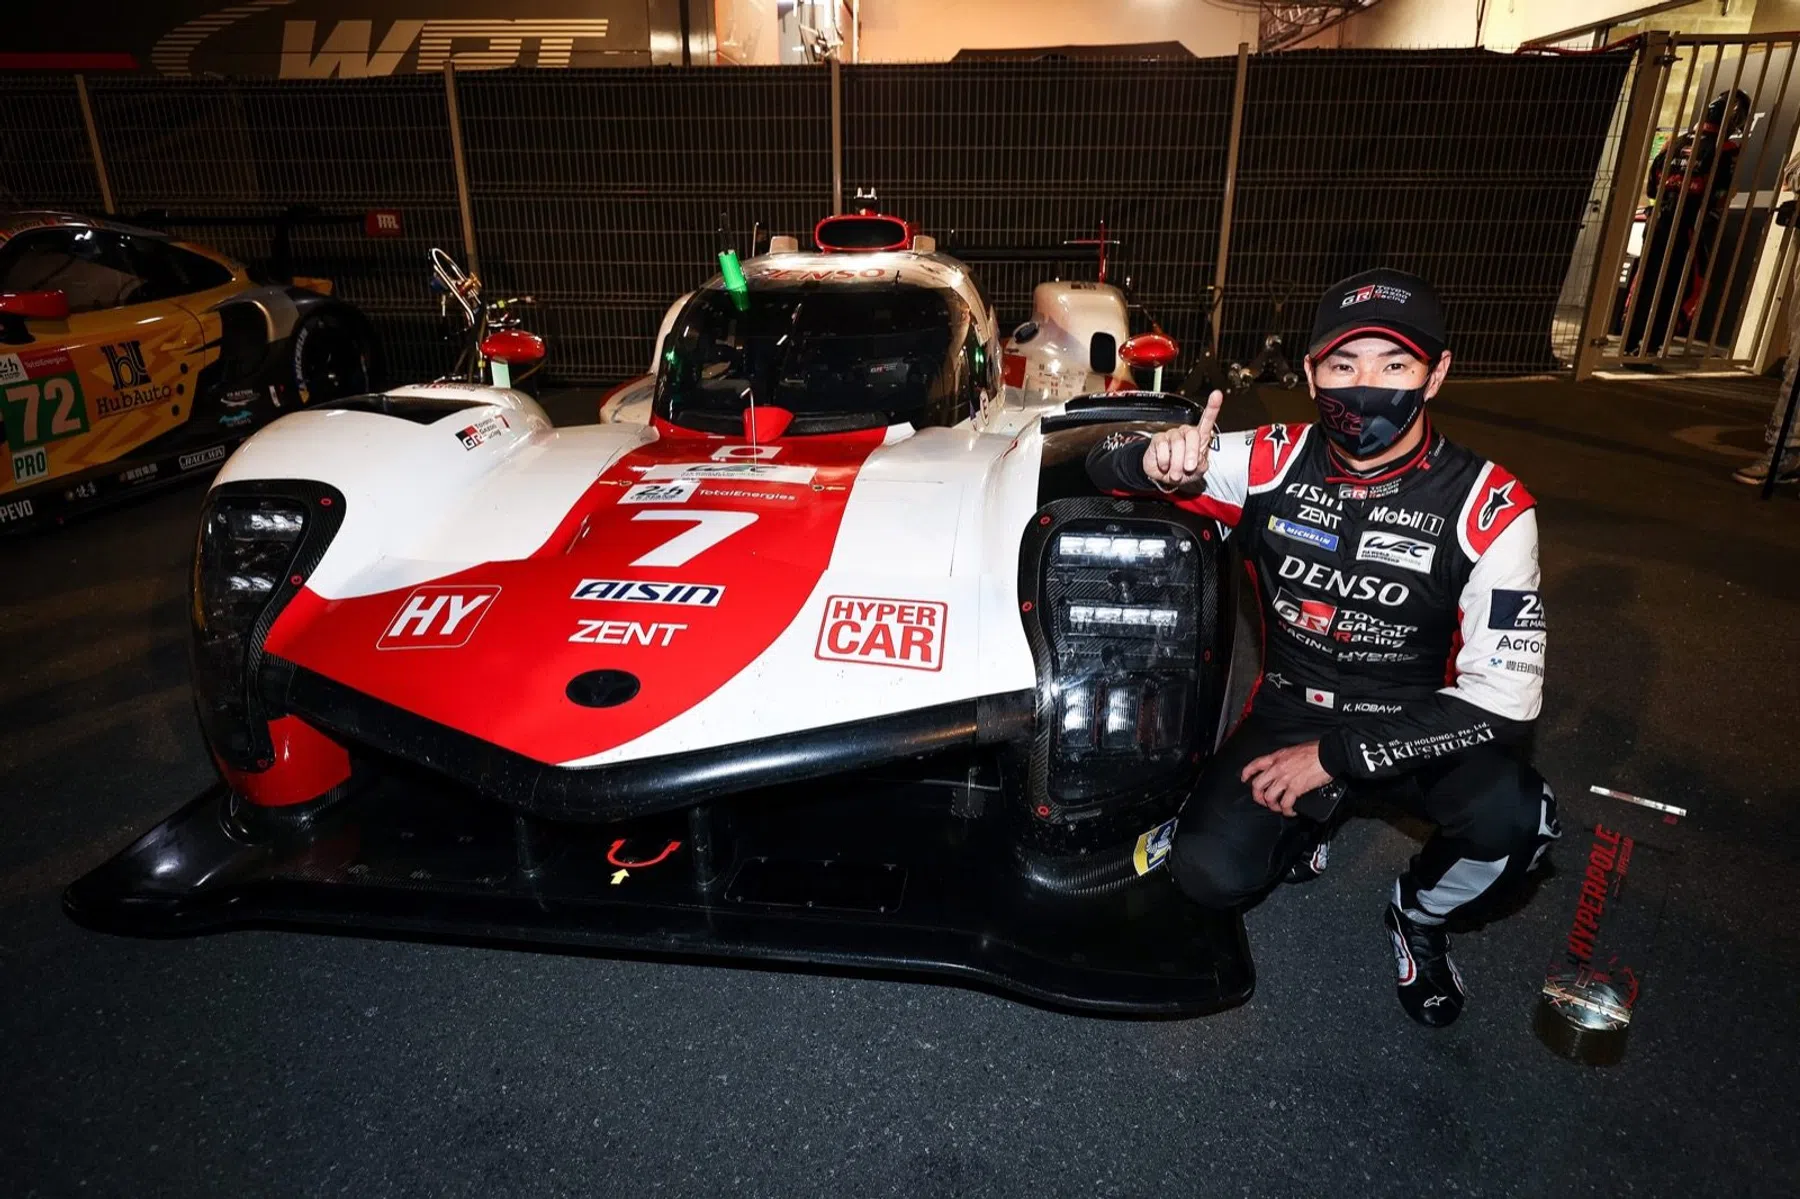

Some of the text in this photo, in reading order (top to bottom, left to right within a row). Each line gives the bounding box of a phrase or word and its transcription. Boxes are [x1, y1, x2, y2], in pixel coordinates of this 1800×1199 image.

[1342, 291, 1370, 306] GR
[6, 377, 81, 442] 72
[95, 383, 172, 416] HubAuto
[14, 451, 46, 479] PRO
[699, 489, 796, 500] TotalEnergies
[1340, 488, 1367, 499] GR
[1297, 504, 1342, 530] ZENT
[1368, 506, 1424, 529] Mobil
[628, 510, 760, 567] 7
[1286, 525, 1330, 545] MICHELIN
[1278, 555, 1409, 606] DENSO
[574, 584, 719, 604] AISIN
[388, 595, 492, 636] HY
[833, 601, 937, 626] HYPER
[1274, 600, 1330, 634] GR
[568, 620, 689, 646] ZENT
[827, 620, 933, 663] CAR
[1333, 631, 1405, 648] Racing
[1343, 703, 1353, 712] K.
[1567, 823, 1621, 960] HYPERPOLE
